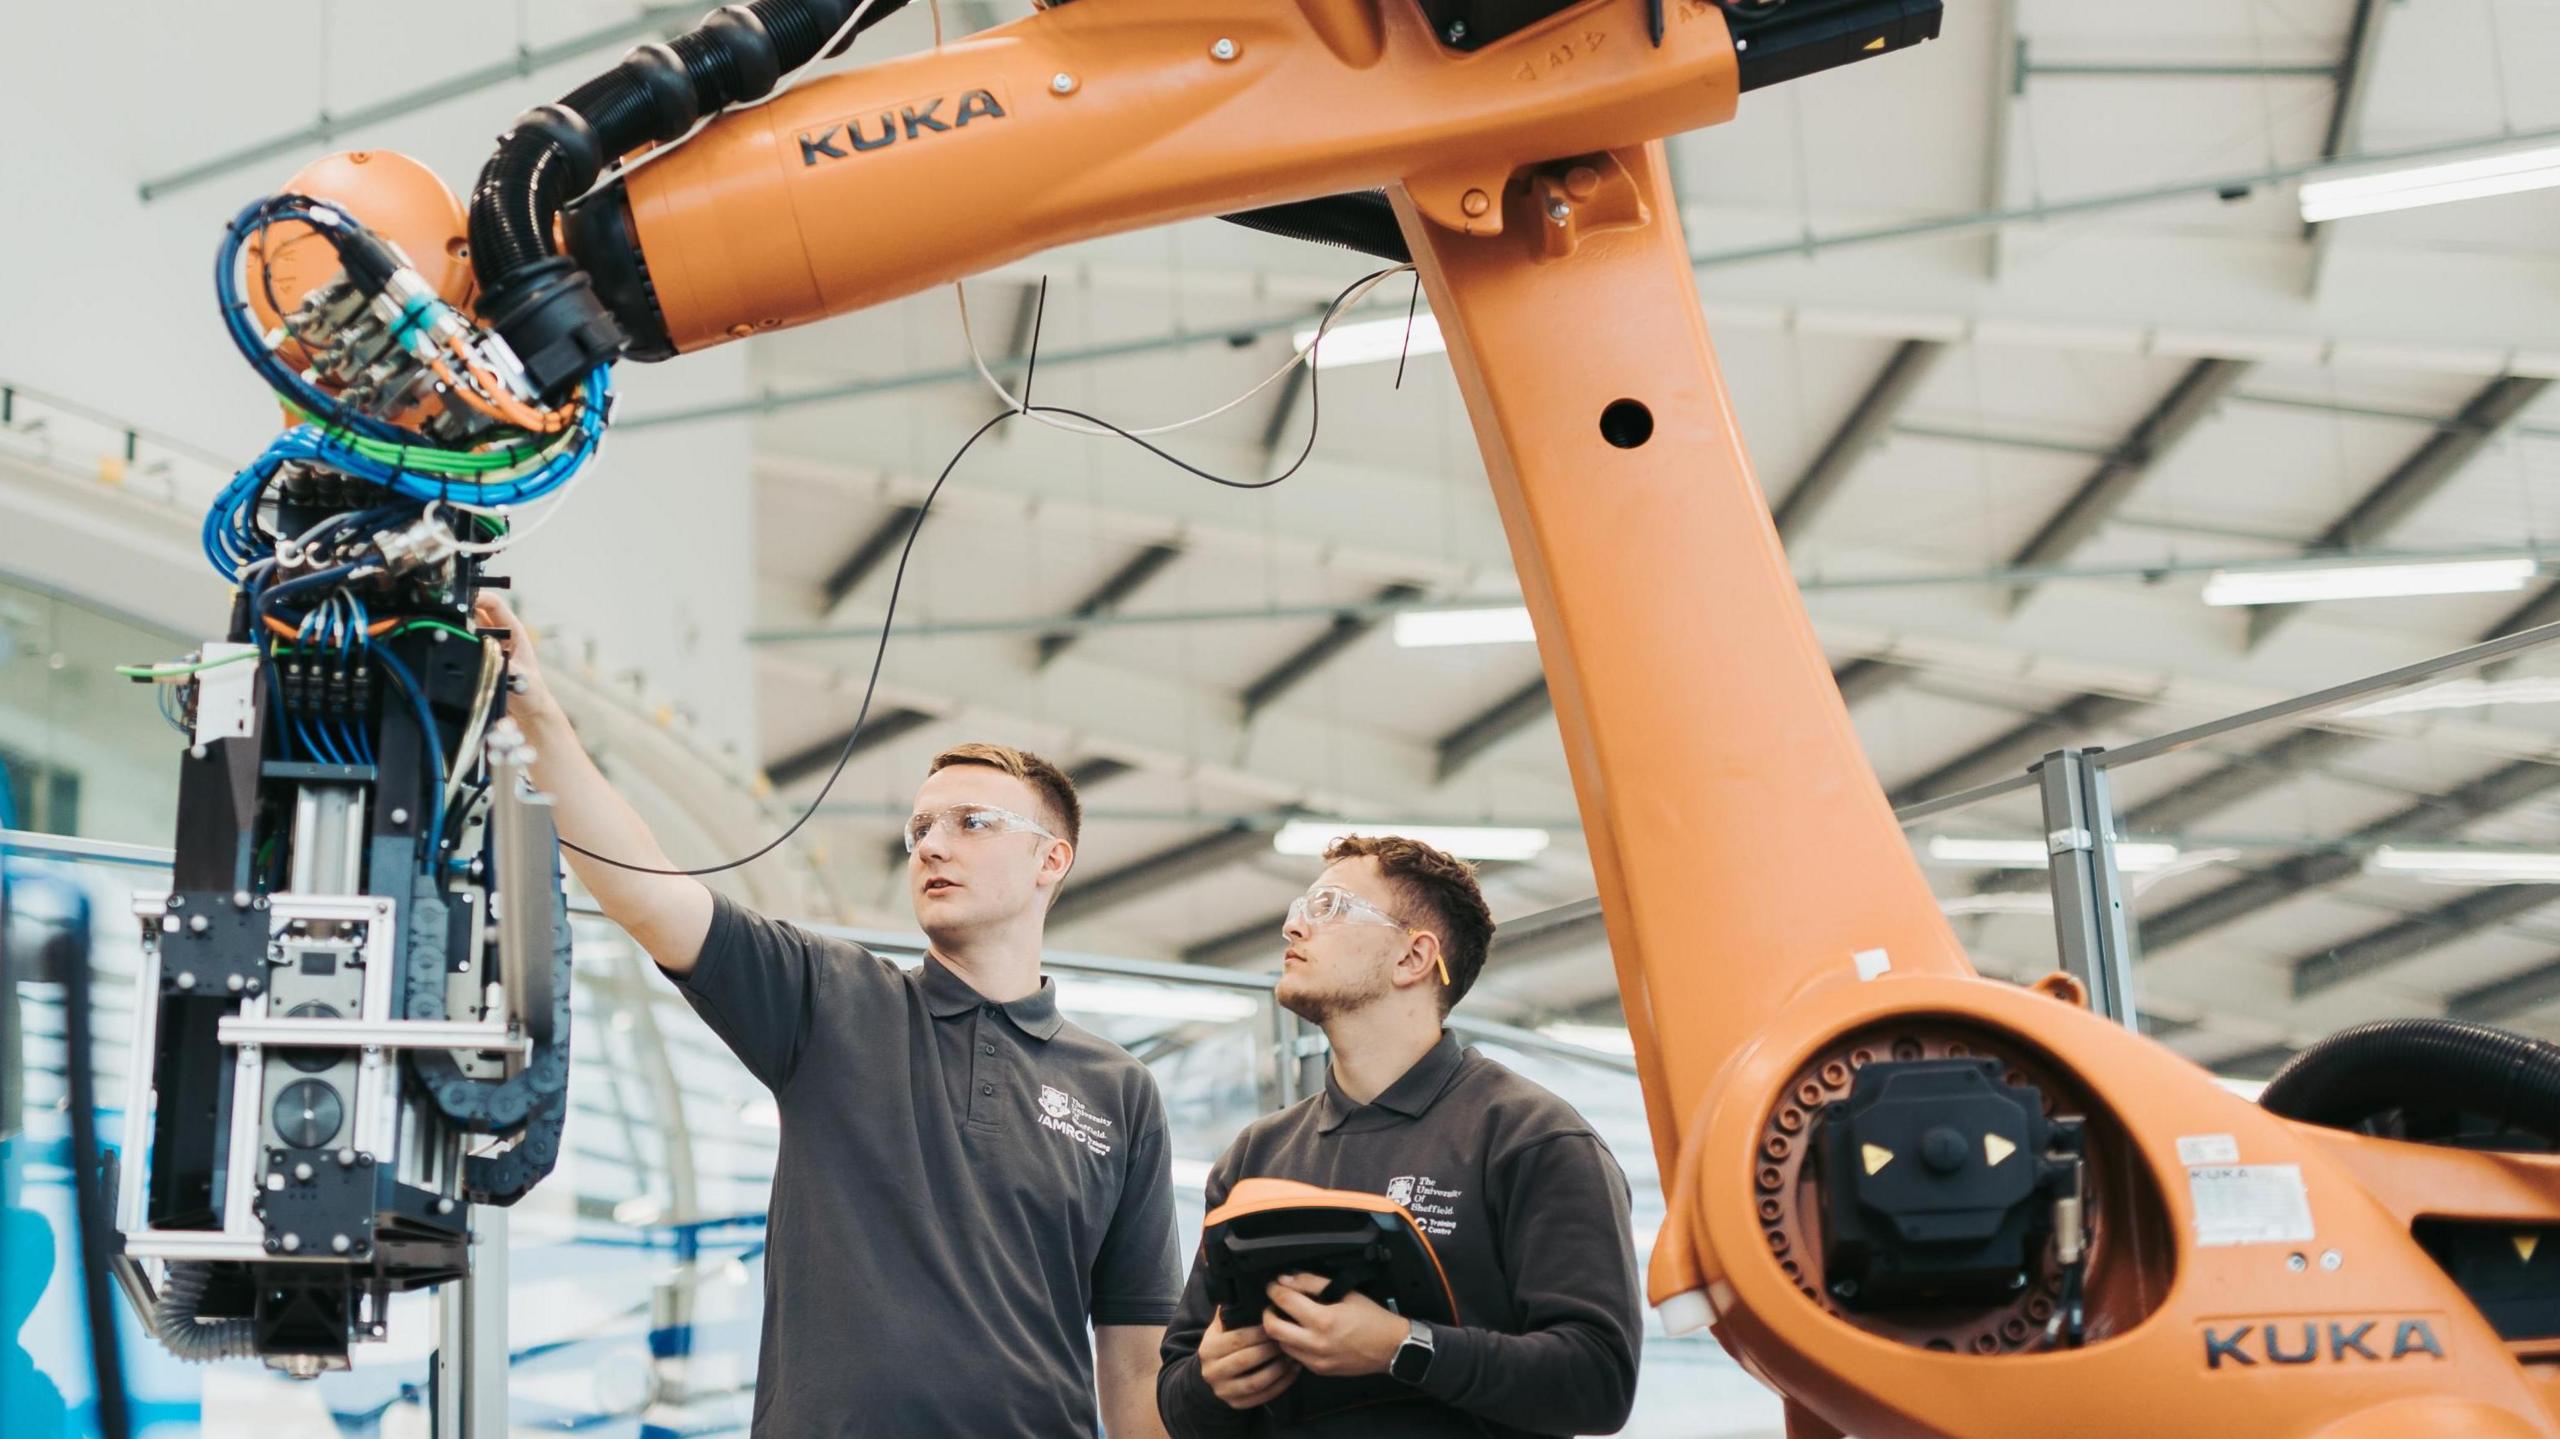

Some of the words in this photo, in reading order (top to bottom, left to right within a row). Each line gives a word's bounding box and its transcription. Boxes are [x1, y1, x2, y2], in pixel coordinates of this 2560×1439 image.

[799, 89, 1006, 166] KUKA
[2190, 1167, 2249, 1181] KUKA
[1419, 1176, 1436, 1187] The
[1416, 1185, 1462, 1198] University
[1414, 1194, 1426, 1203] Of
[1429, 1218, 1457, 1230] Training
[1427, 1226, 1452, 1236] Centre
[2204, 1319, 2446, 1370] KUKA
